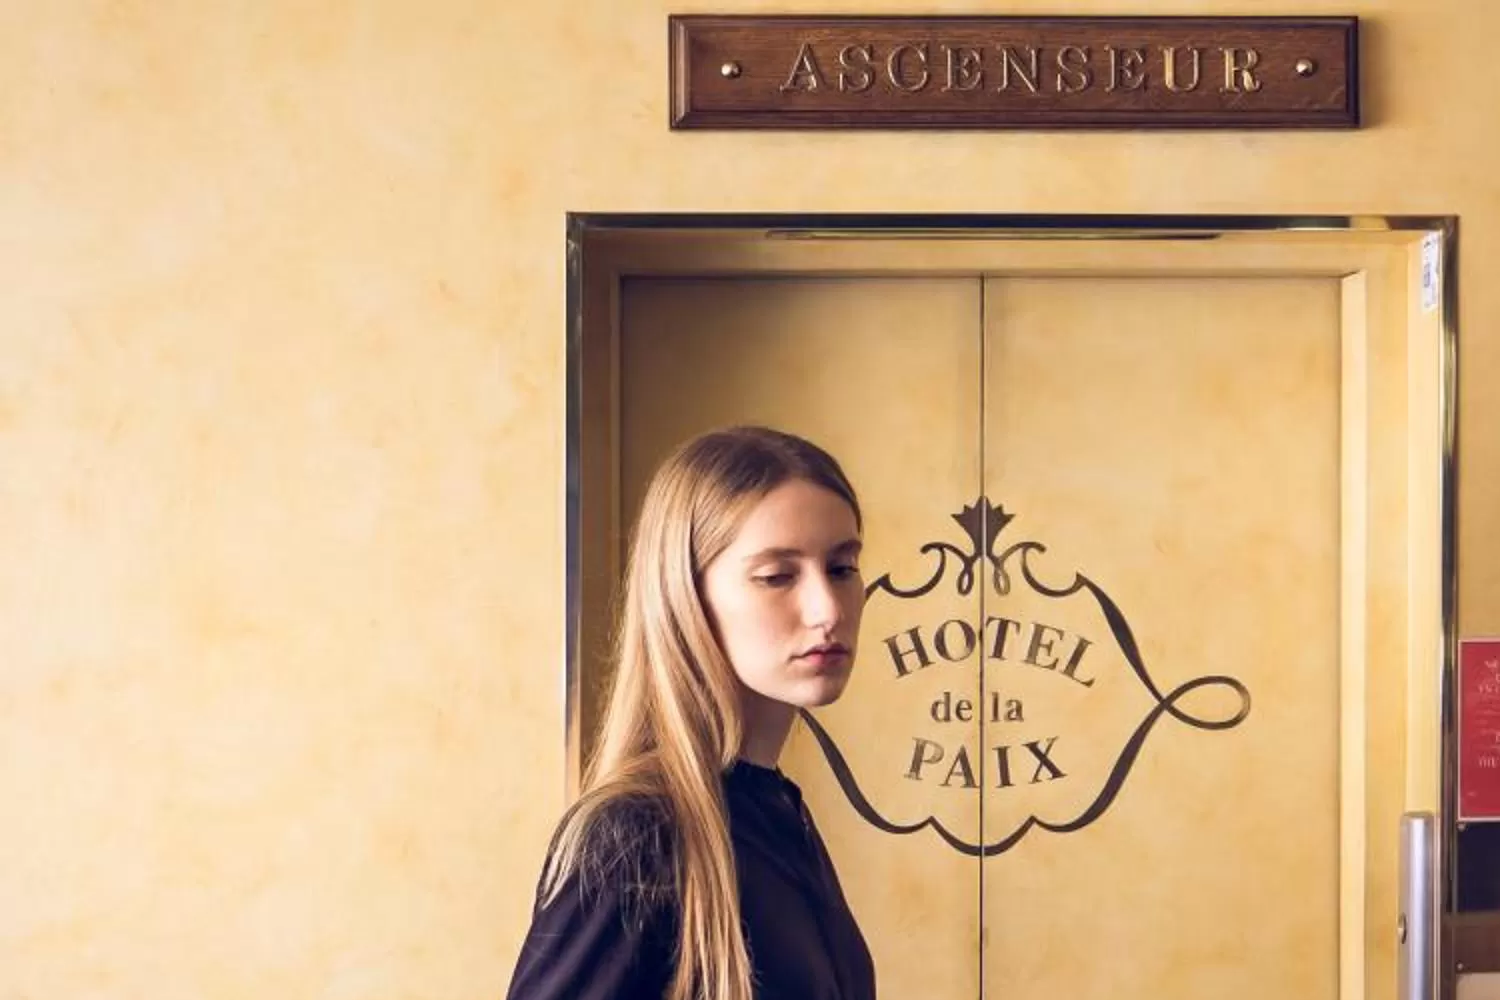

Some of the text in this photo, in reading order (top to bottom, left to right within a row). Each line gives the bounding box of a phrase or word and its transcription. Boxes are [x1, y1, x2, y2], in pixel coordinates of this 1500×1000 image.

[779, 42, 1264, 94] ASCENSEUR
[882, 615, 1096, 688] HOTEL
[930, 691, 1025, 723] de la
[903, 736, 1068, 790] PAIX
